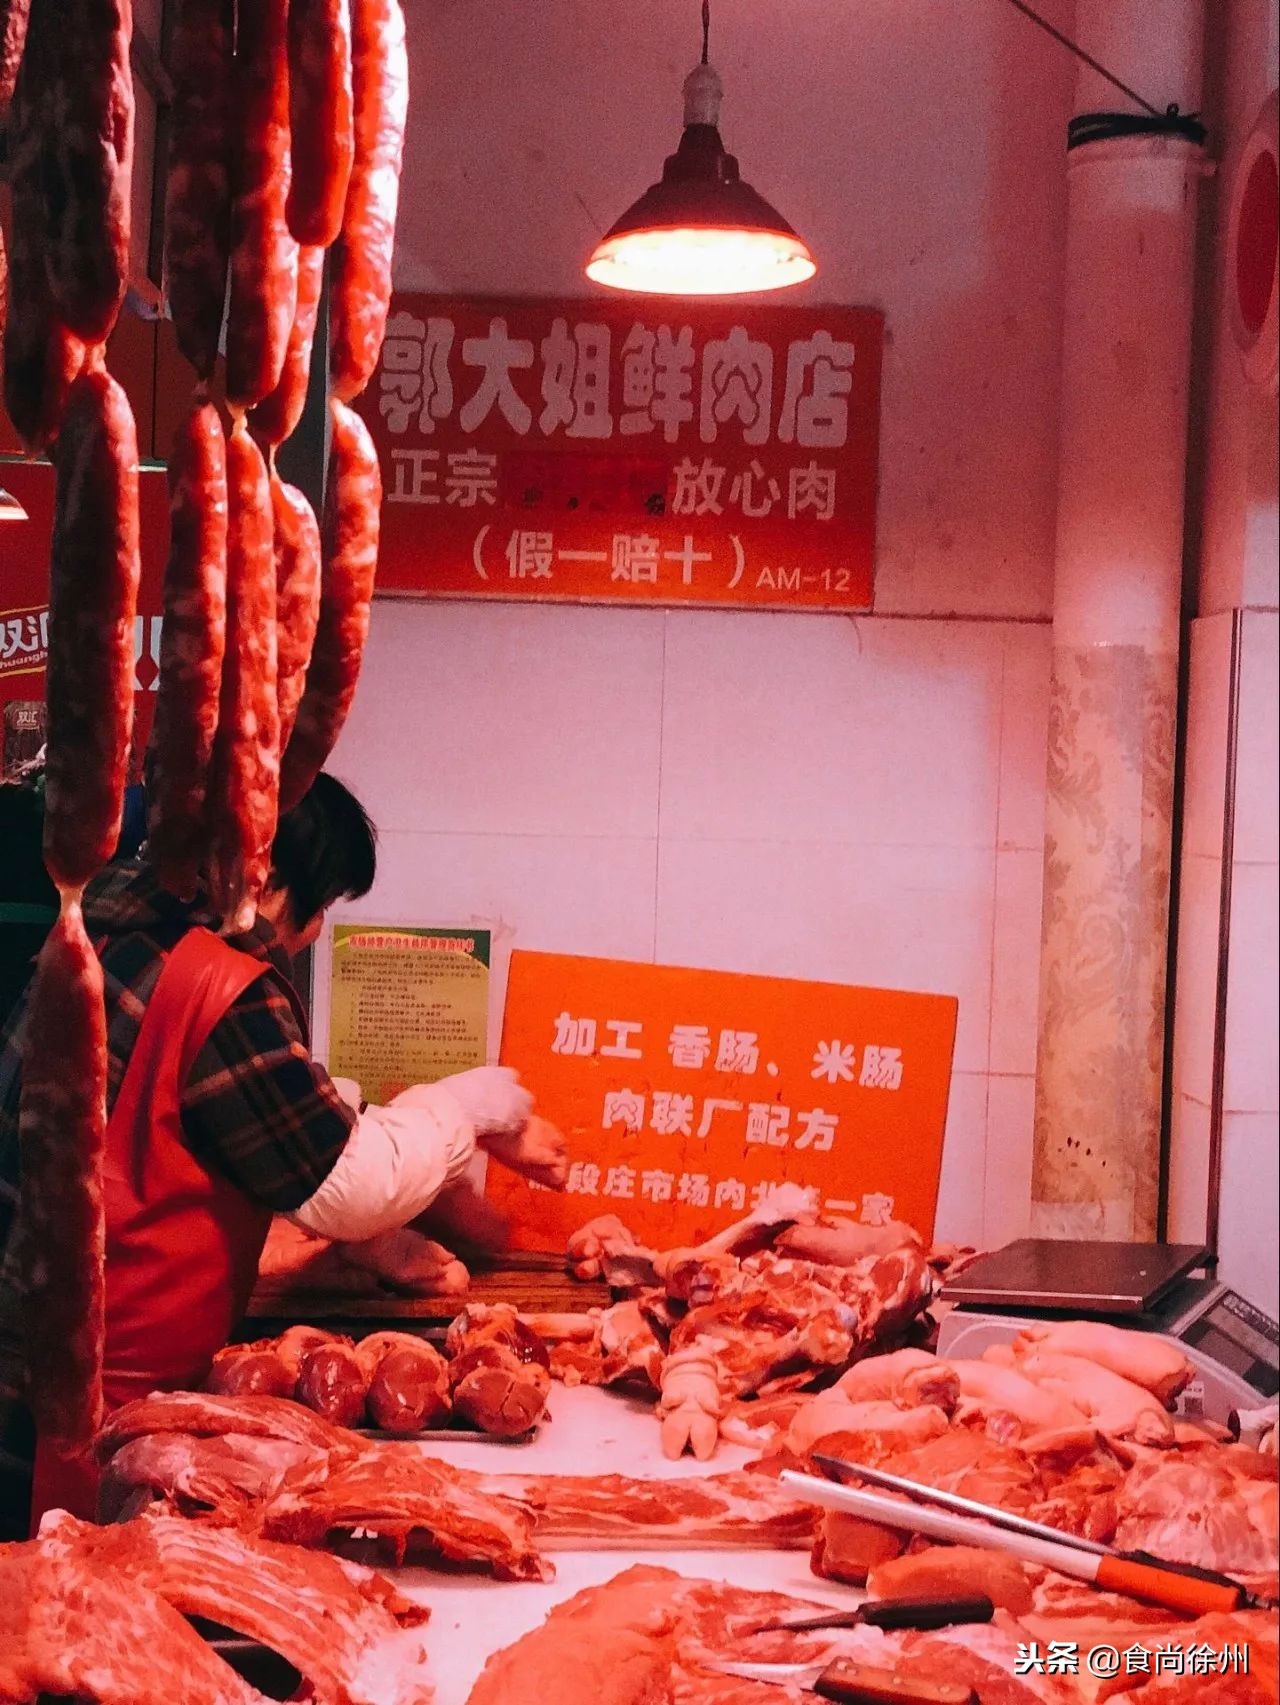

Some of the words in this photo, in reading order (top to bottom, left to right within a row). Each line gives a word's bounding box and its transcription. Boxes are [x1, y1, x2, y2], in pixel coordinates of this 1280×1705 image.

[379, 311, 855, 448] 郭大姐鲜肉店
[388, 448, 497, 506] 正宗
[672, 457, 836, 521] 放心肉
[756, 567, 851, 592] AM-12
[552, 1012, 643, 1060] 加工
[602, 1087, 839, 1151] 肉联厂配方
